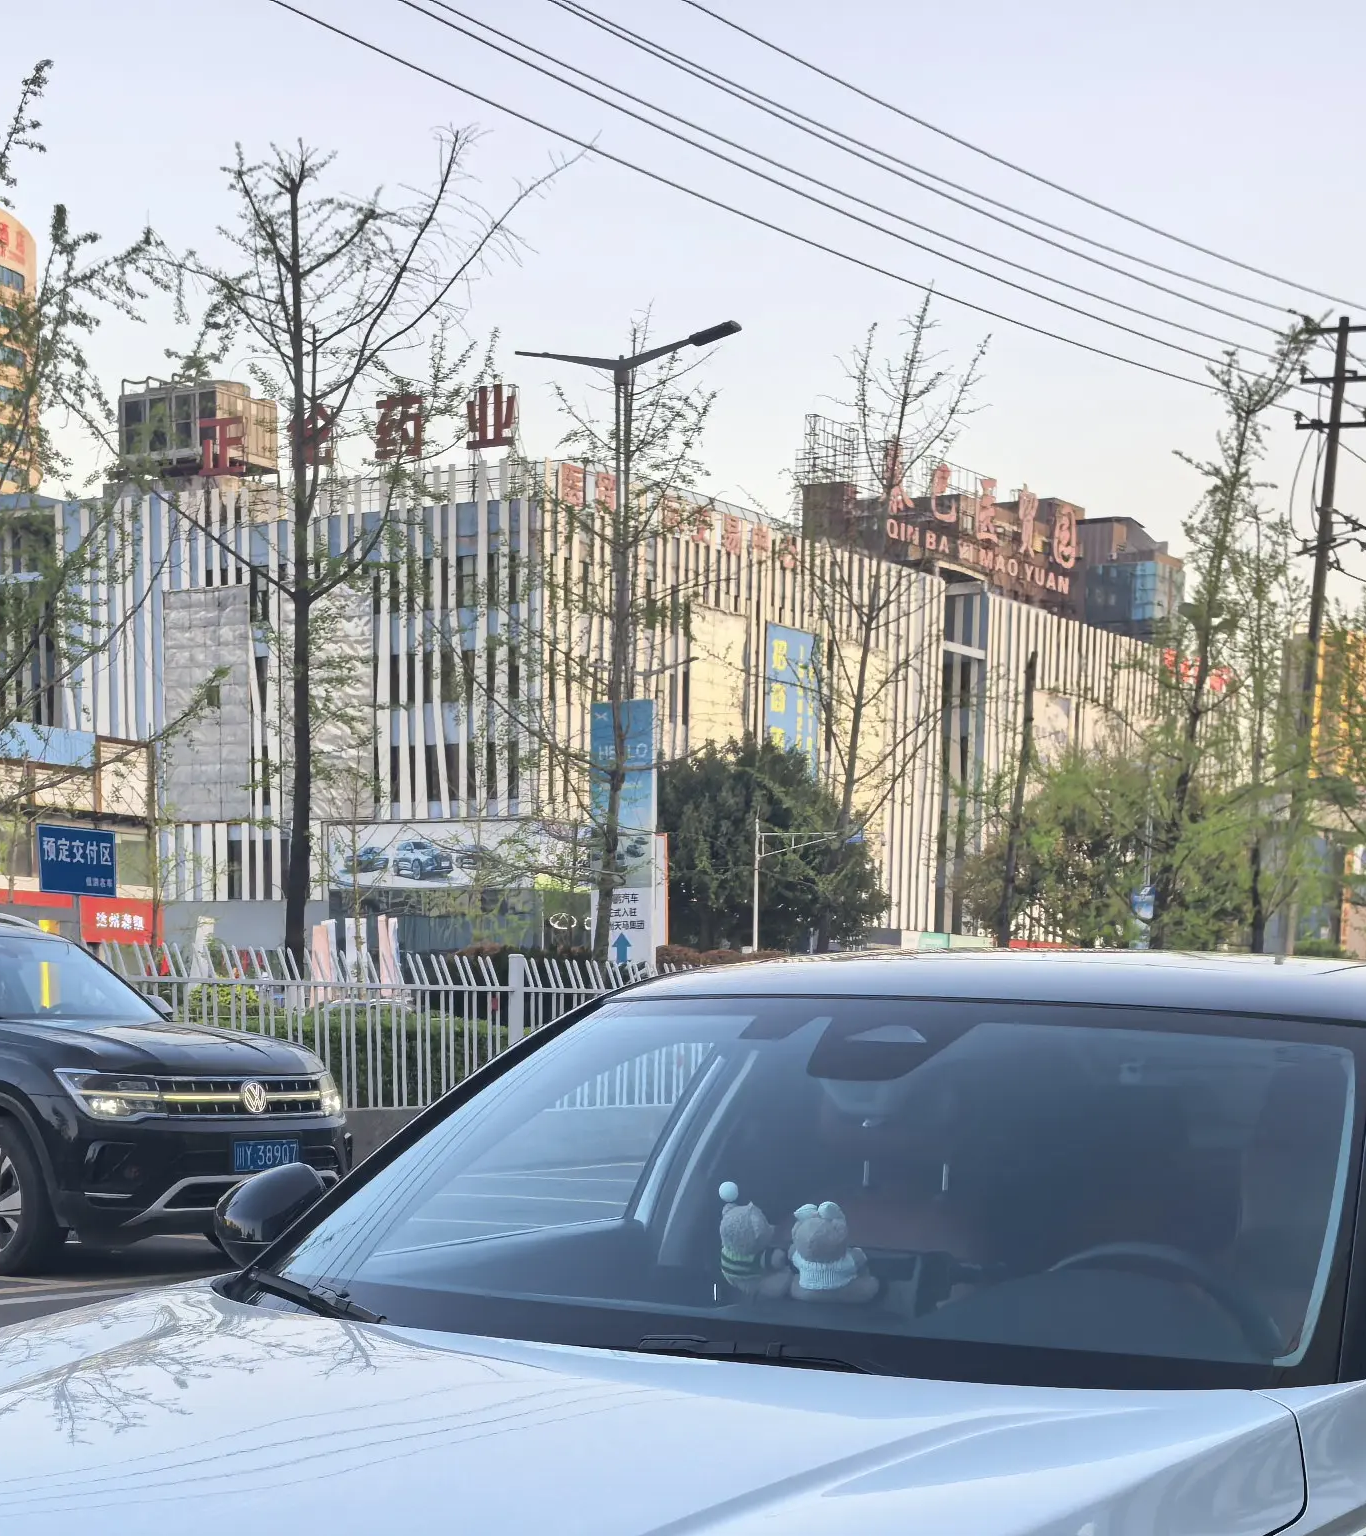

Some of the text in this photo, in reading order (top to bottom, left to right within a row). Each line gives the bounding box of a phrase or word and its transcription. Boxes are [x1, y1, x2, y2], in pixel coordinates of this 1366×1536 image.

[886, 518, 920, 545] QIN
[925, 529, 950, 554] BA
[979, 544, 1019, 577] MAO
[1023, 562, 1070, 595] YUAN
[598, 742, 648, 761] HELO
[42, 837, 112, 866] 预定交付区
